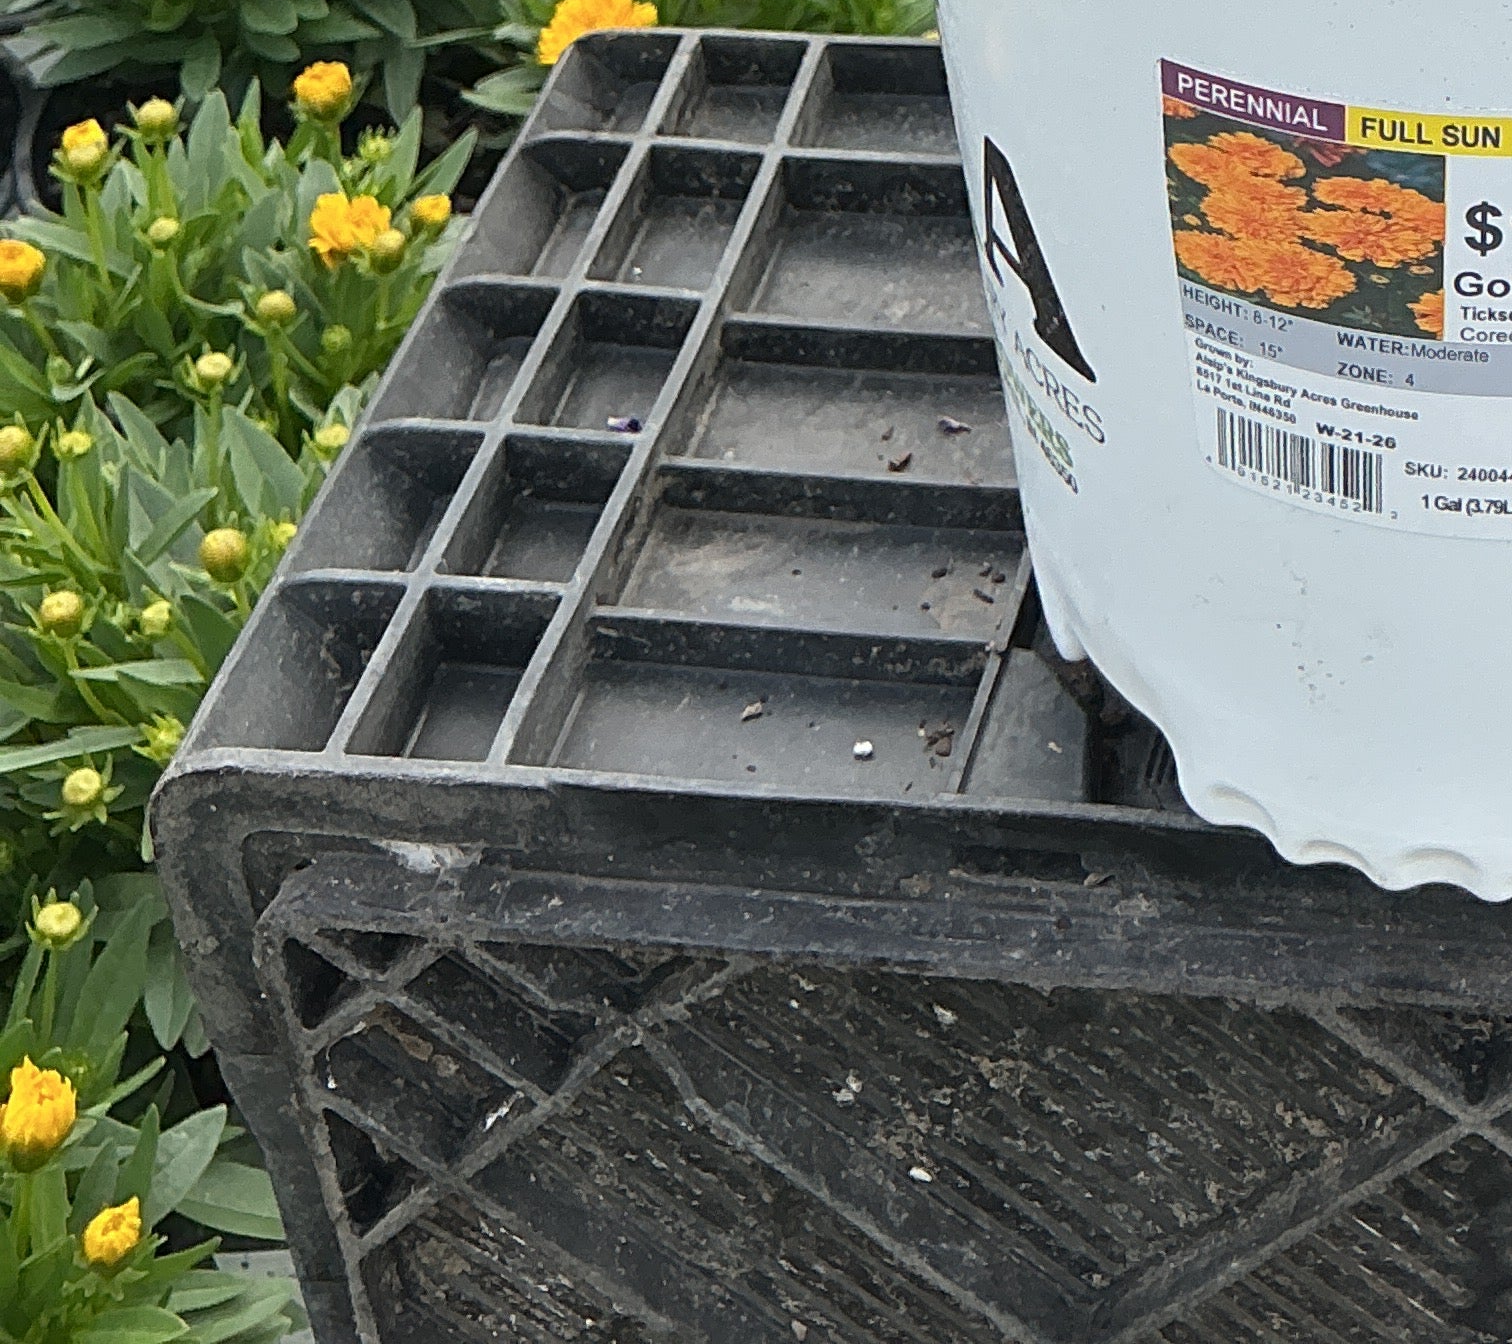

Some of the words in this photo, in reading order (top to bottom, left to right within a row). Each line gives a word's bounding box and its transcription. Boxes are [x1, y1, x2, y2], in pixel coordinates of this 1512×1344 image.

[1176, 71, 1329, 132] PERENNIAL
[1361, 115, 1433, 146] FULL
[1441, 124, 1502, 149] SUN
[1182, 284, 1249, 322] HEIGHT:
[1184, 313, 1245, 348] SPACE:
[1336, 331, 1410, 357] WATER:
[1411, 343, 1490, 363] Moderate
[1336, 361, 1394, 386] ZONE:
[1404, 373, 1415, 388] 4
[1273, 394, 1292, 409] Rd
[1300, 388, 1338, 407] Acres
[1340, 397, 1419, 421] Greenhouse
[1315, 421, 1398, 449] W-21-26
[1403, 460, 1449, 480] SKU:
[1420, 494, 1429, 510] 1
[1433, 495, 1463, 512] Gal
